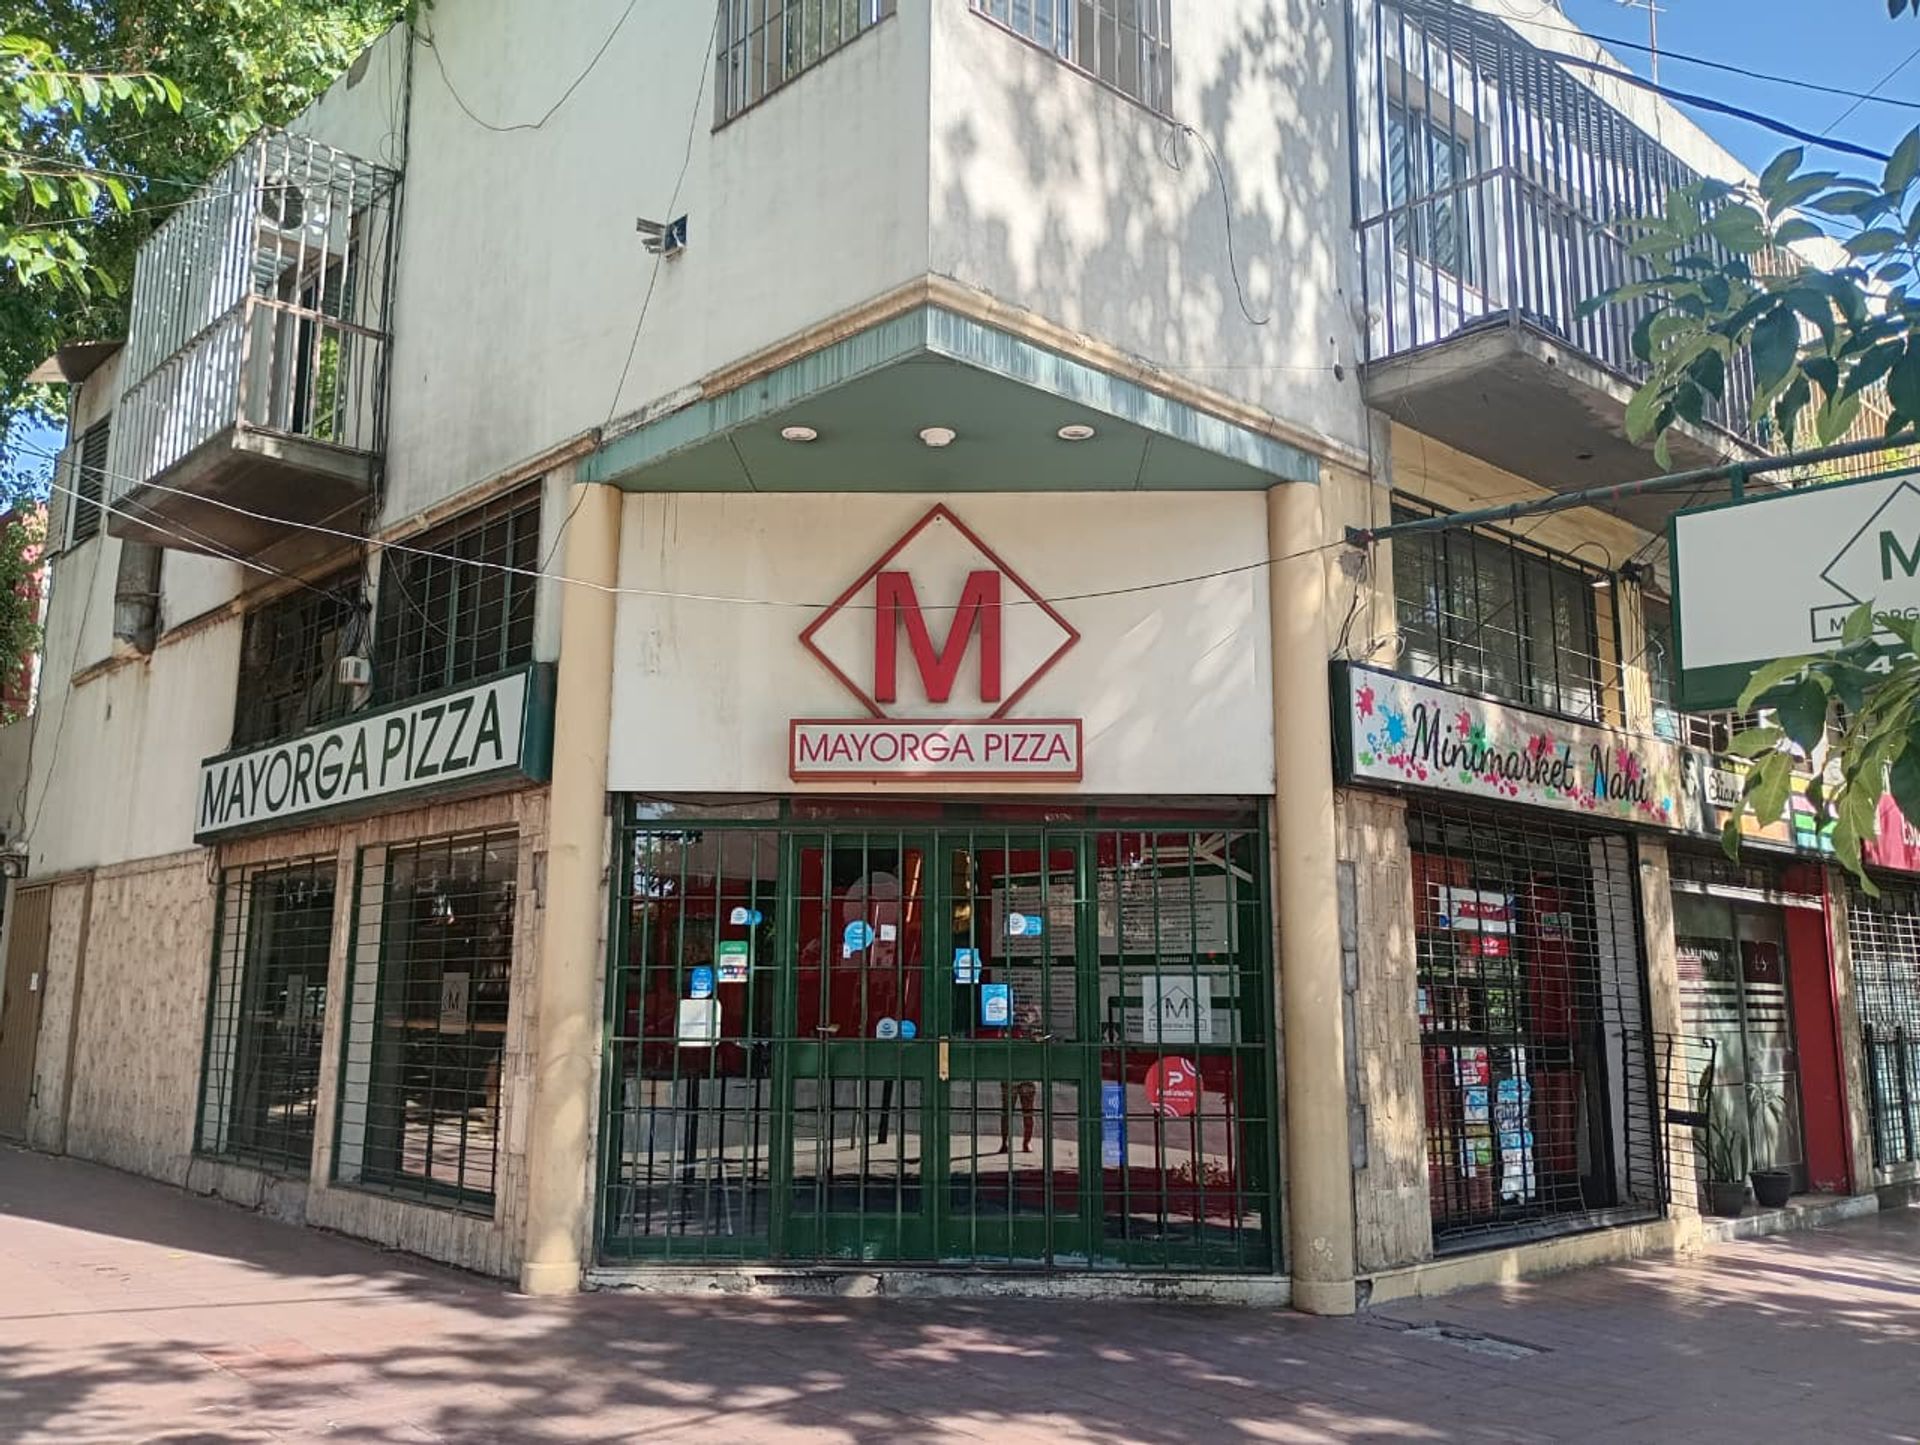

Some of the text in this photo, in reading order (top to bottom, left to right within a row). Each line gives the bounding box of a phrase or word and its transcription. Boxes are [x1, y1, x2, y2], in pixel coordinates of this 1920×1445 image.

[1880, 530, 1920, 580] M
[875, 570, 1001, 703] M
[201, 689, 503, 828] MAYORGA PIZZA
[799, 732, 1072, 763] MAYORGA PIZZA
[1408, 703, 1575, 790] Minimarket
